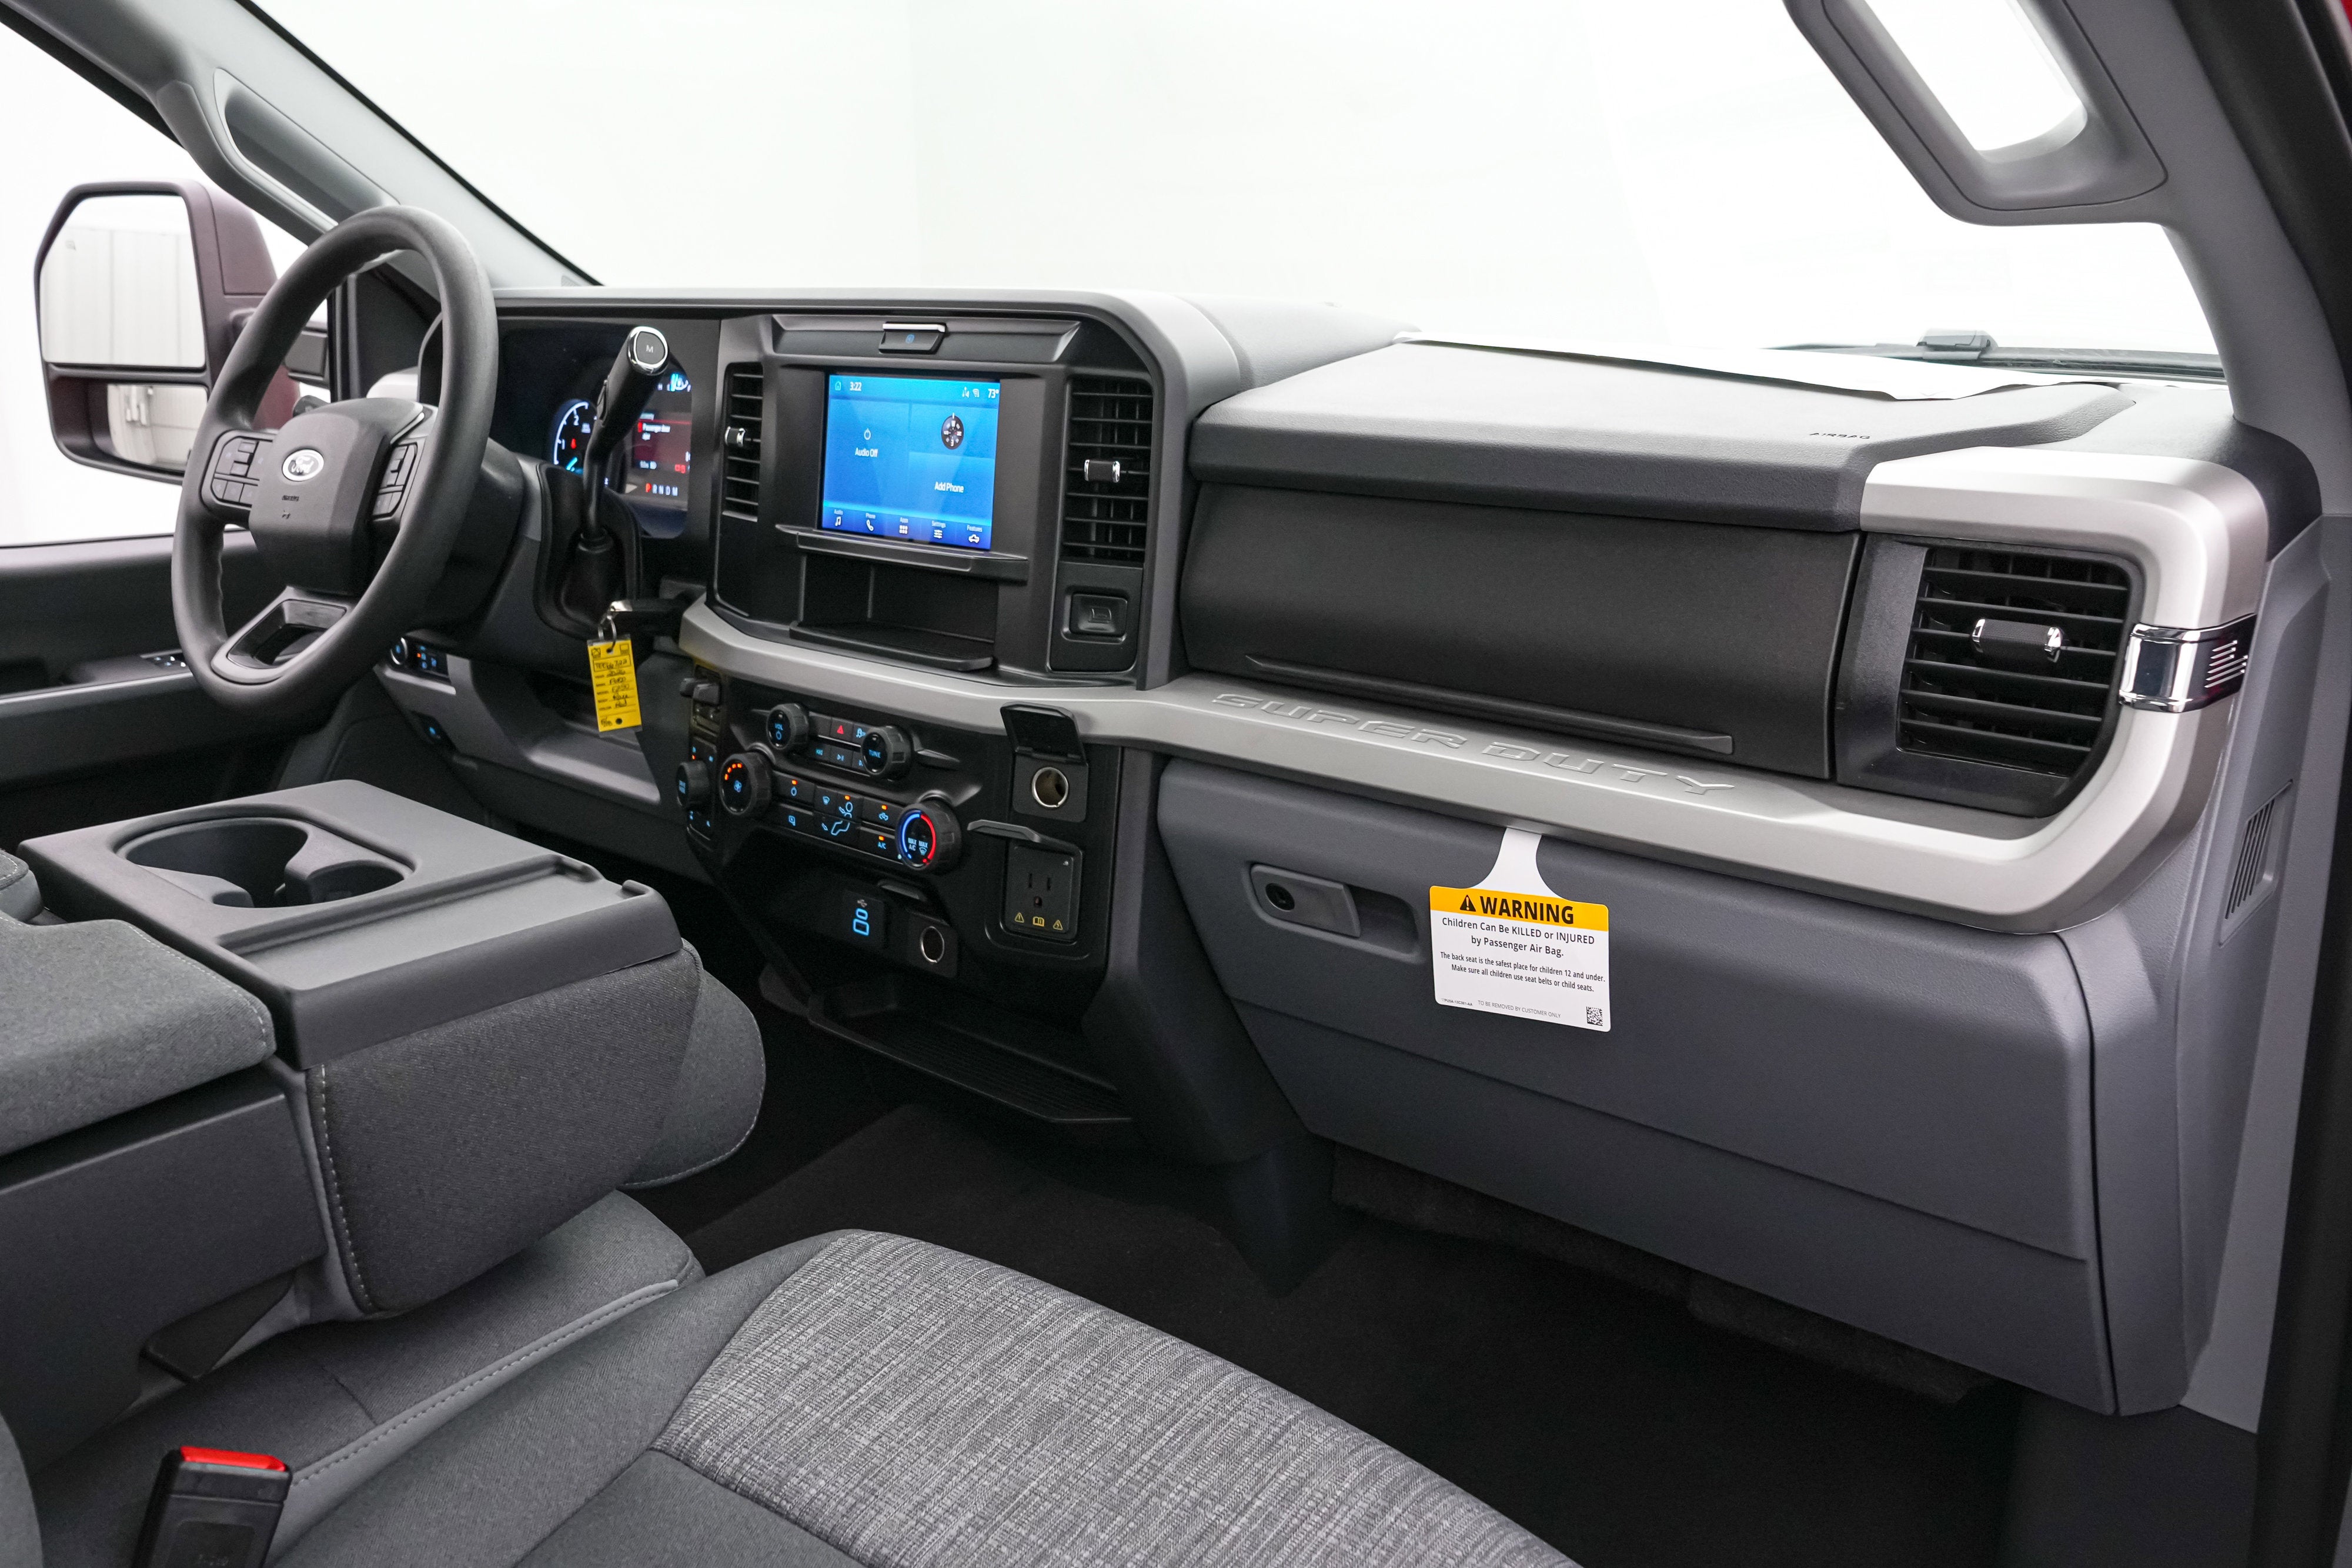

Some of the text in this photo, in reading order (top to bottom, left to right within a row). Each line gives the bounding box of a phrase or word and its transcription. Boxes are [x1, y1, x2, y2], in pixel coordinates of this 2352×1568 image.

[854, 447, 878, 457] Audio Off
[935, 482, 964, 493] Add Phone
[868, 749, 881, 758] TUNE
[1211, 694, 1735, 795] SUPER DUTY
[877, 841, 886, 850] A/C
[1479, 895, 1574, 925] WARNING
[1442, 917, 1478, 930] Children
[1480, 922, 1496, 932] Can
[1499, 924, 1509, 934] Be
[1512, 926, 1541, 938] KILLED
[1556, 932, 1595, 945] INJURED
[1471, 935, 1564, 958] by Passenger Air Bag.
[1441, 951, 1451, 959] The
[1452, 953, 1464, 961] back
[1495, 959, 1512, 968] safest
[1513, 962, 1528, 971] place
[1539, 966, 1563, 975] children
[1586, 974, 1606, 982] under.
[1451, 964, 1466, 972] Make
[1489, 971, 1512, 979] children
[1538, 977, 1552, 985] belts
[1562, 981, 1575, 989] child
[1577, 984, 1594, 992] seats.
[1492, 1002, 1514, 1011] REMOVED
[1522, 1007, 1548, 1017] CUSTOMER
